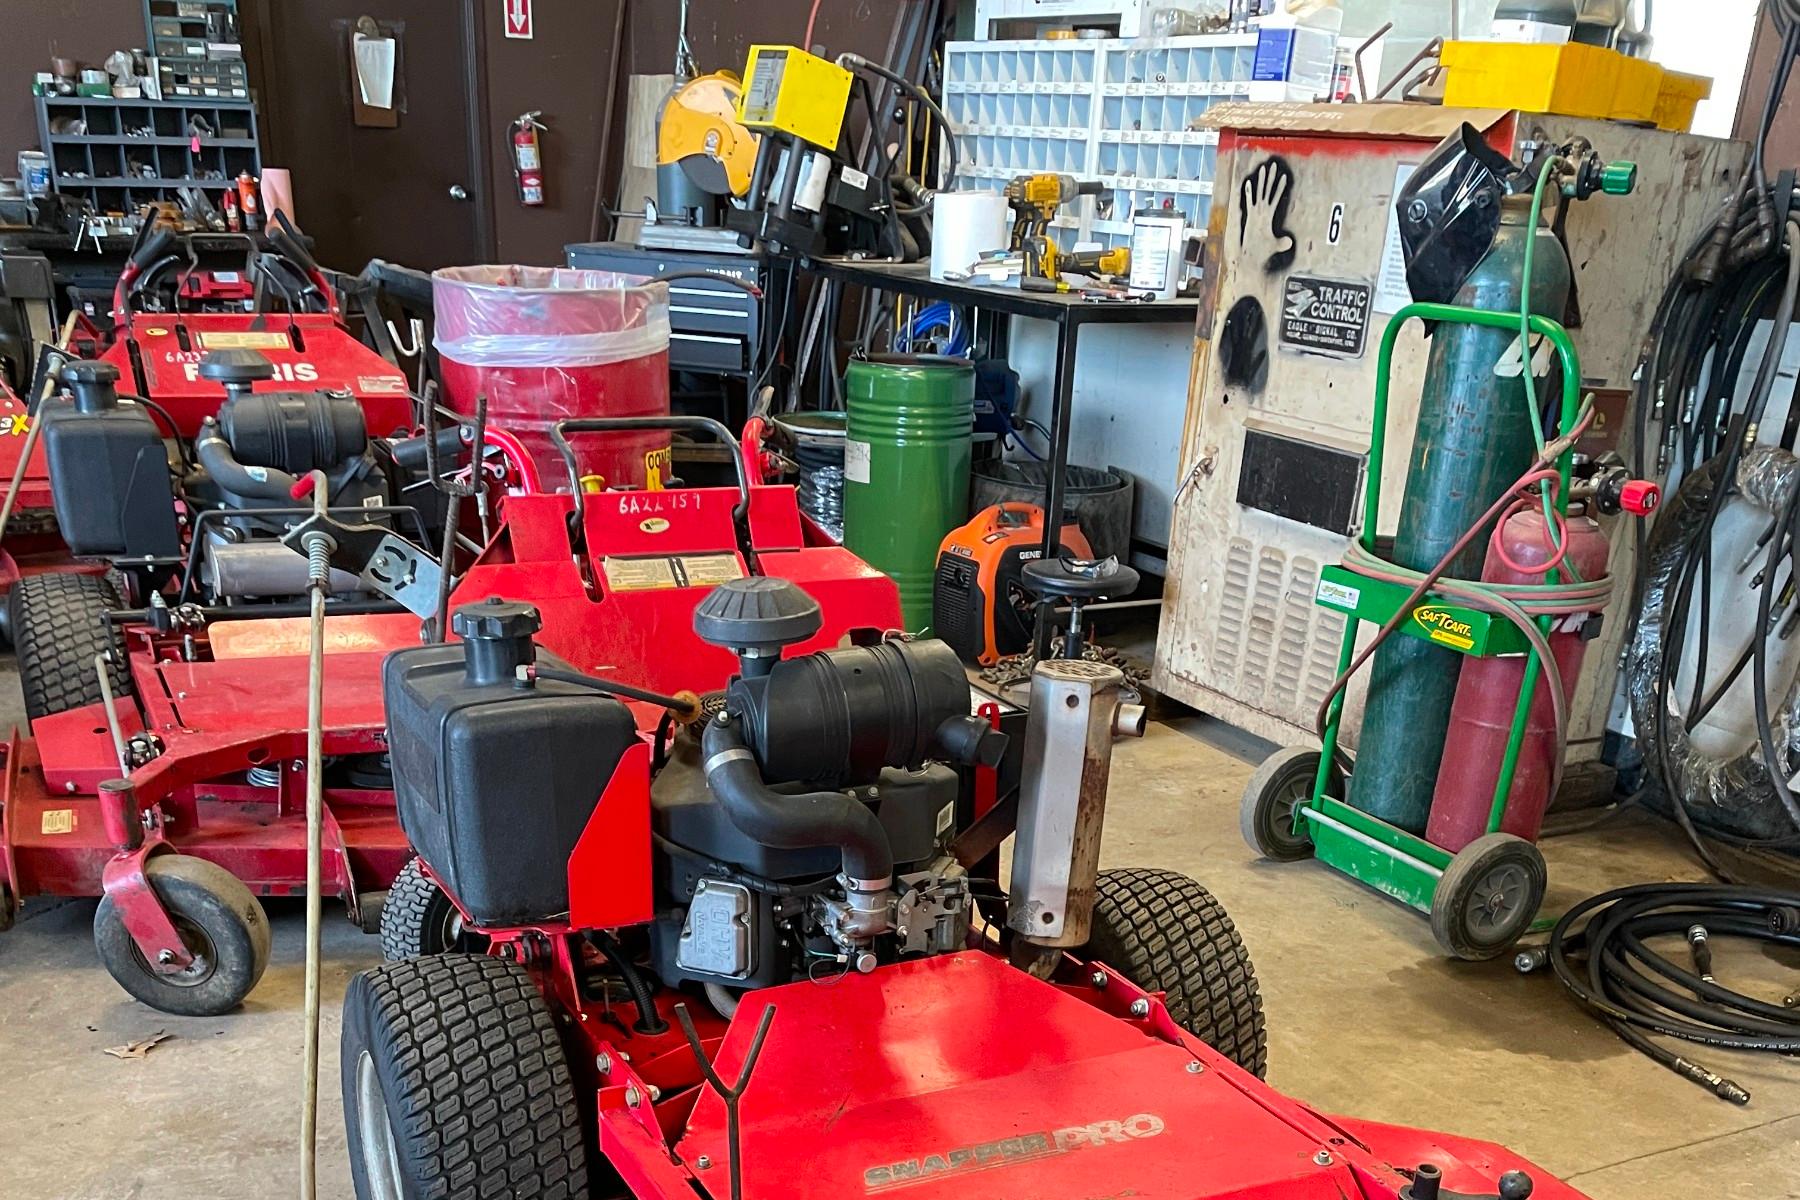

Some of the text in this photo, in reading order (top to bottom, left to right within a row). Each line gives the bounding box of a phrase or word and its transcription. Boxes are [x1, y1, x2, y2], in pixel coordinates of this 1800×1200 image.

[1329, 205, 1342, 243] 6
[1319, 286, 1366, 307] TRAFFIC
[1311, 303, 1363, 323] CONTROL
[1019, 550, 1042, 560] GENE
[864, 1113, 1165, 1187] SNAPPER PRO
